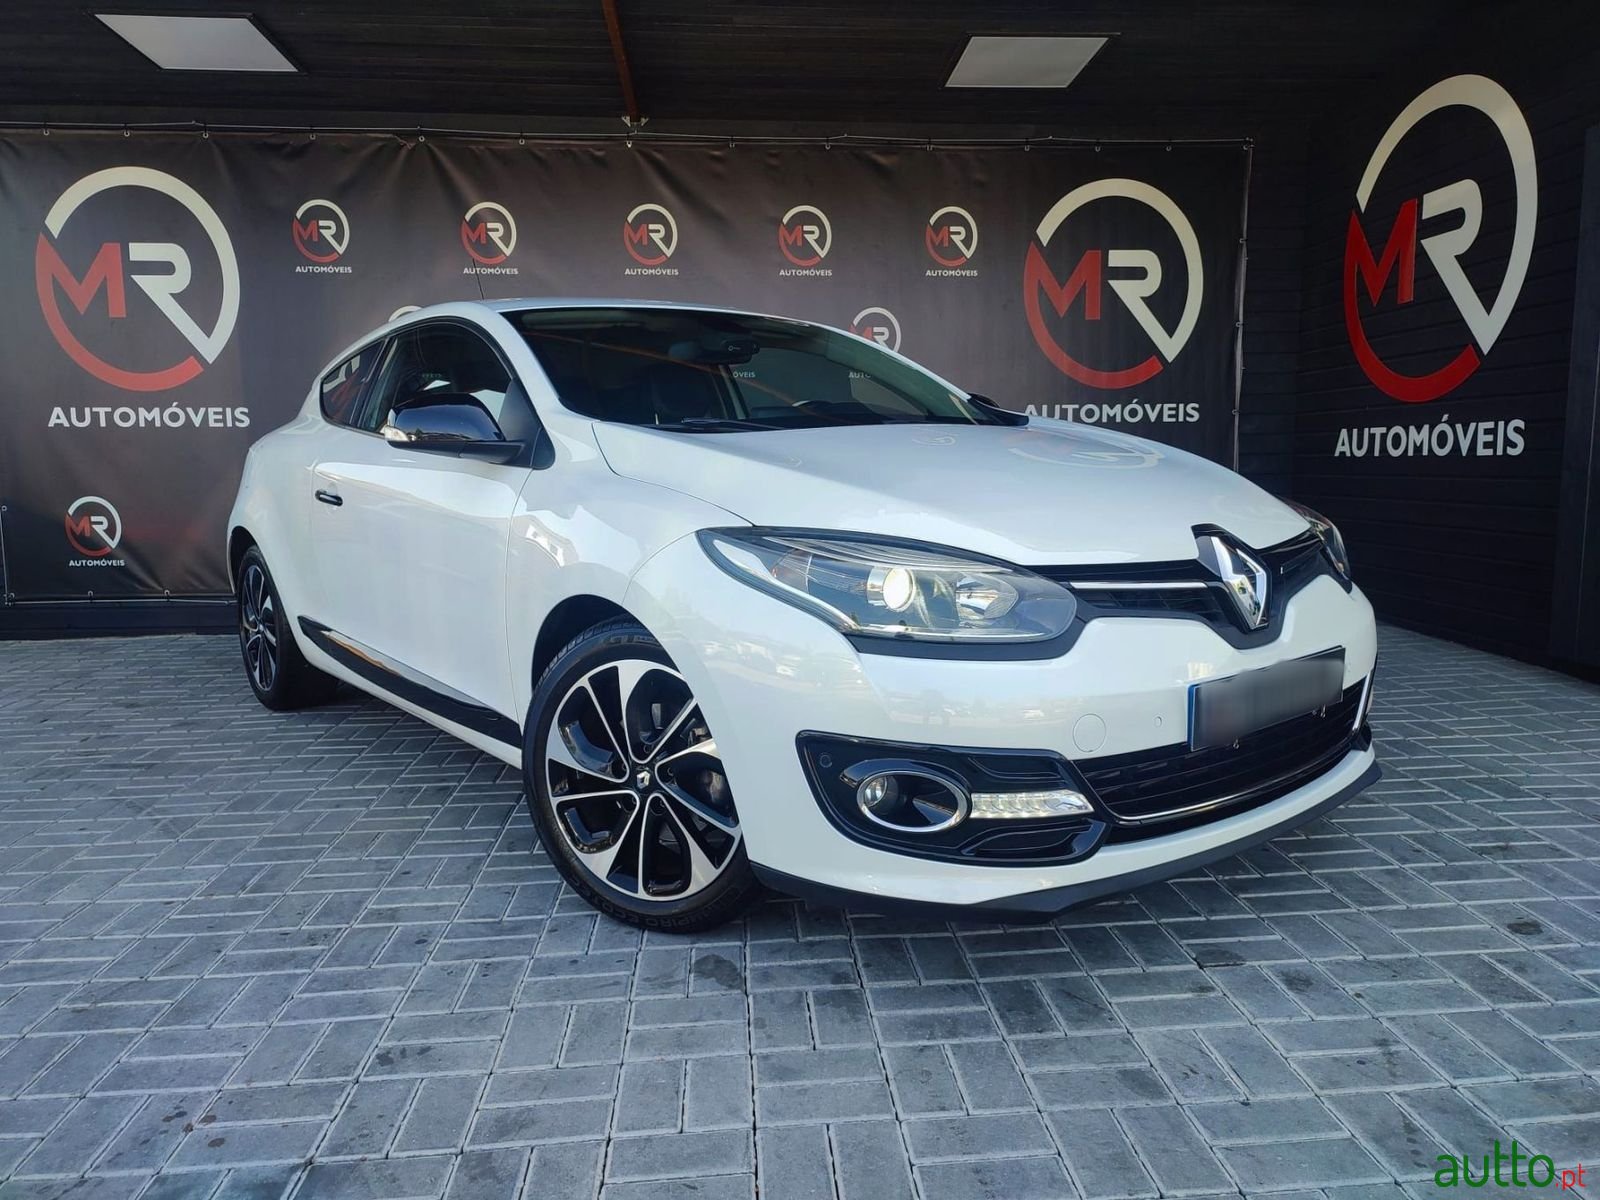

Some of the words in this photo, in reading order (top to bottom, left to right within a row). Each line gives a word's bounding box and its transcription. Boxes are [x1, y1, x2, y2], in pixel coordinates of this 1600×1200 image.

[295, 265, 352, 274] AUTOMÓVEIS
[463, 267, 519, 275] AUTOMÓVEIS
[624, 268, 679, 276] AUTOMÓVEIS
[779, 268, 832, 277] AUTOMÓVEIS
[926, 268, 979, 277] AUTOMÓVEIS
[48, 402, 250, 428] AUTOMÓVEIS
[1024, 398, 1200, 423] AUTOMÓVEIS
[1334, 414, 1525, 458] AUTOMÓVEIS
[69, 558, 125, 567] AUTOMÓVEIS
